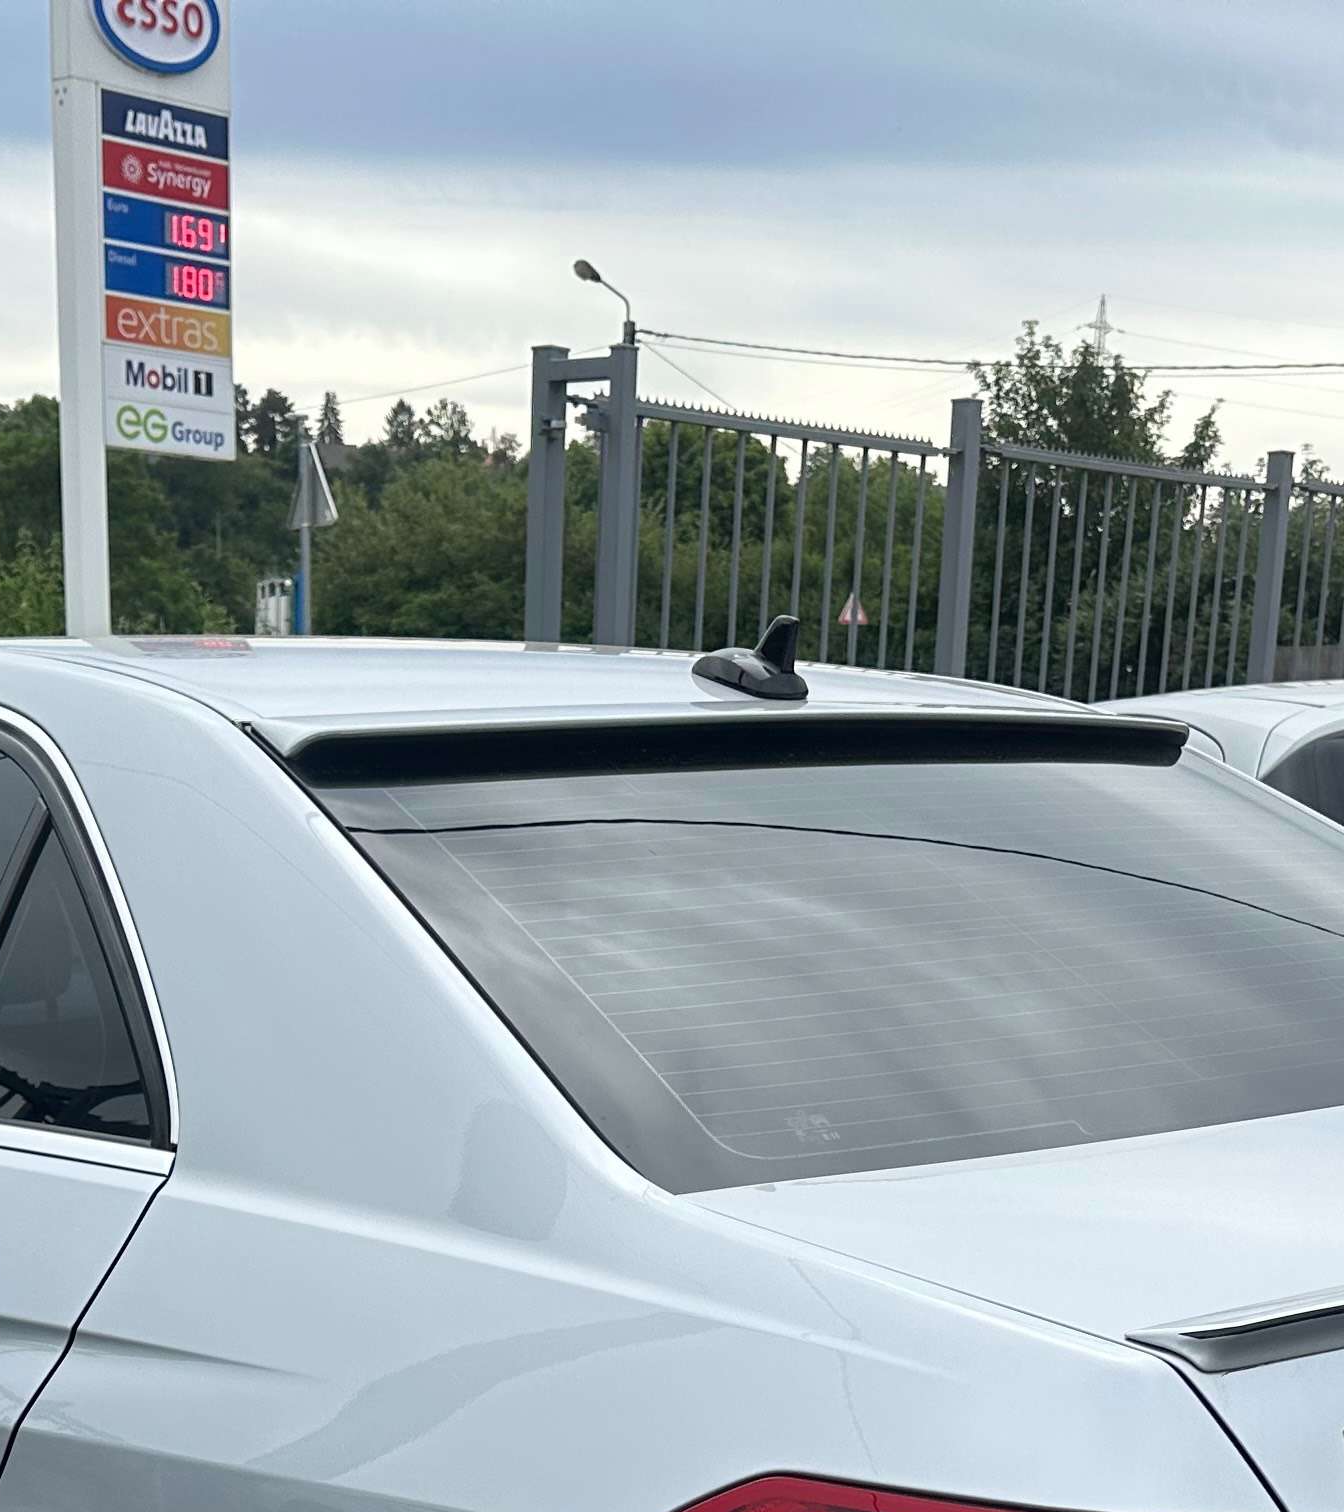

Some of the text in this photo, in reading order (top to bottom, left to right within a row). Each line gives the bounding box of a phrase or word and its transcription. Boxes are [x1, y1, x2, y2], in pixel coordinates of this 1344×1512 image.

[125, 109, 207, 149] LAVAZZA
[147, 163, 212, 198] Synergy
[117, 307, 219, 351] extras
[125, 360, 189, 393] Mobil
[171, 421, 225, 450] Group
